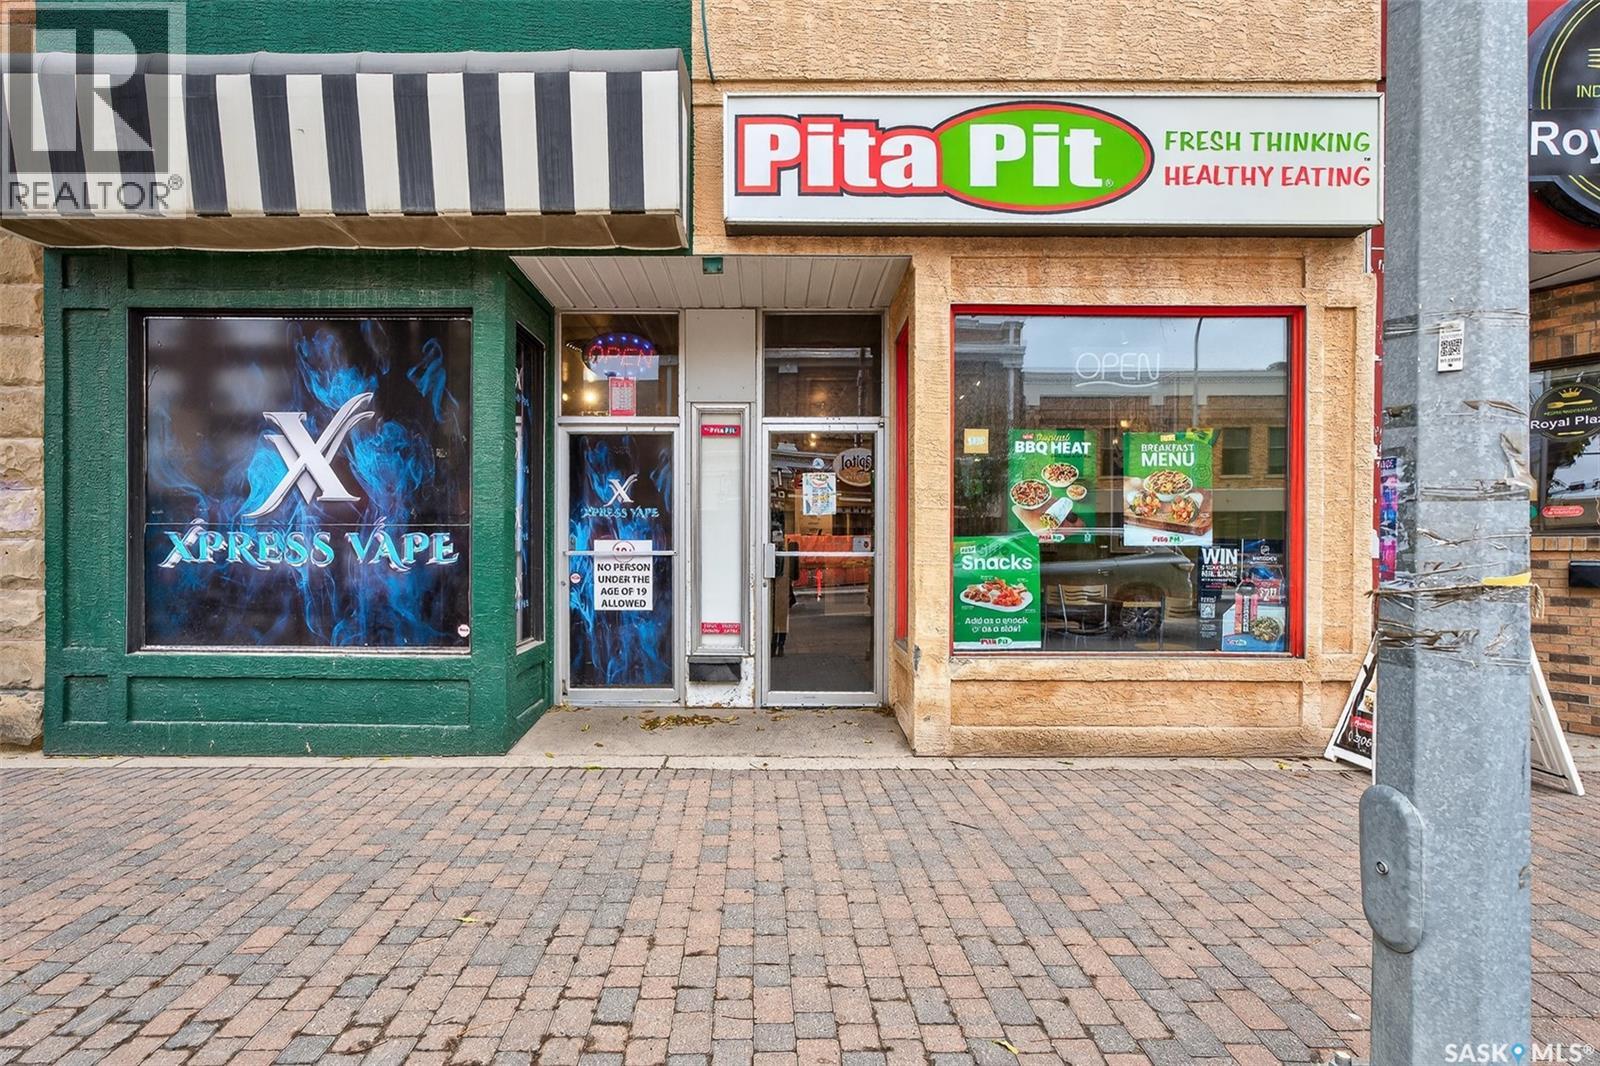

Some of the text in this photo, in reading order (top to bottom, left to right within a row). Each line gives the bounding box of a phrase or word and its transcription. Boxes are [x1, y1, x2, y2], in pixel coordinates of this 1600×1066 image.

[1164, 131, 1371, 153] FRESH THINKING
[744, 124, 940, 187] Pita
[1164, 165, 1371, 188] HEALTHY EATING
[1075, 352, 1160, 381] OPEN
[1530, 415, 1600, 430] Royal Pla
[1014, 441, 1092, 455] BBQ HEAT
[1141, 444, 1195, 452] BREAKFAST
[1141, 452, 1195, 467] MENU
[630, 505, 660, 519] VAPE
[158, 515, 461, 573] XPRESS VAPE
[961, 554, 1032, 570] Snacks
[1201, 548, 1238, 565] WIN
[597, 563, 651, 571] NO PERSON
[598, 575, 650, 583] UNDER THE
[601, 587, 647, 596] AGE OF 19
[601, 599, 647, 608] ALLOWED
